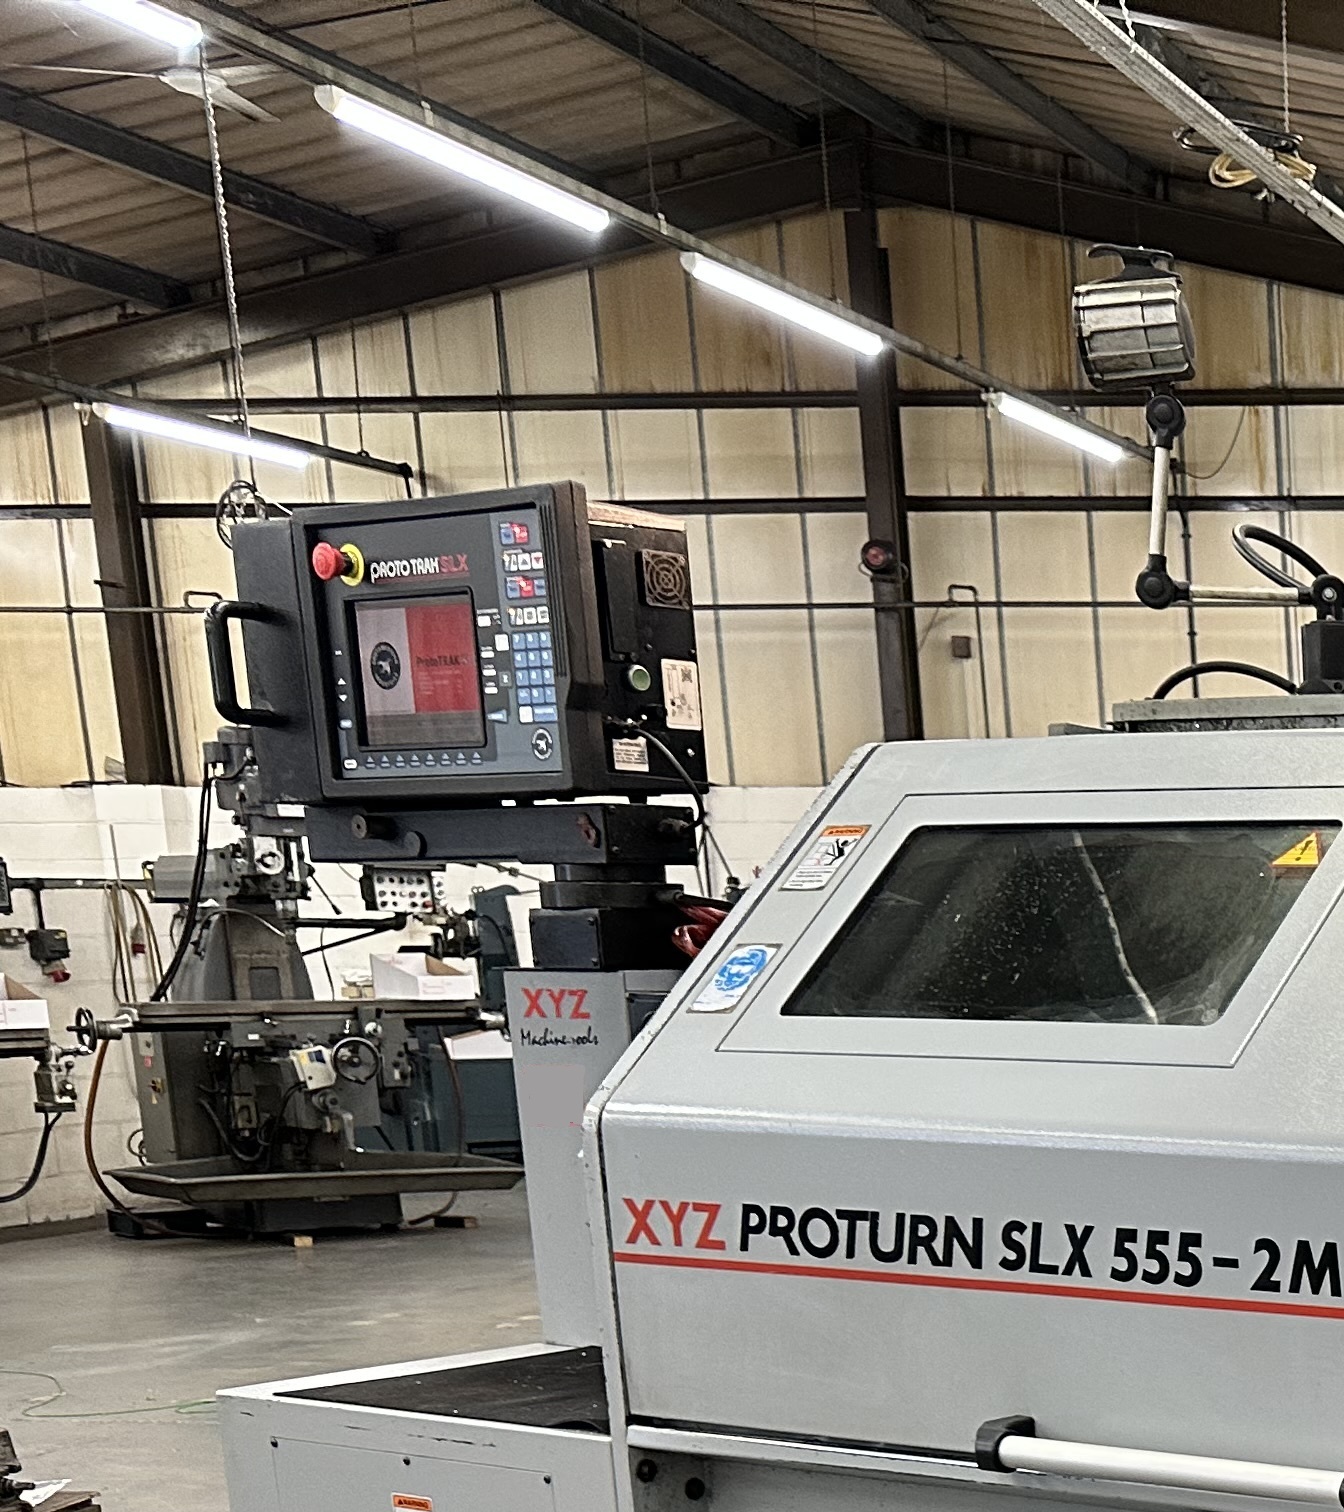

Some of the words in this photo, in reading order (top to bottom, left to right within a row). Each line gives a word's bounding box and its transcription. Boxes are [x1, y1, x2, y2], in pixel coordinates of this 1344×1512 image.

[521, 987, 591, 1020] XYZ
[622, 1197, 727, 1251] XYZ
[739, 1203, 984, 1270] PROTURN
[998, 1220, 1095, 1278] SLX
